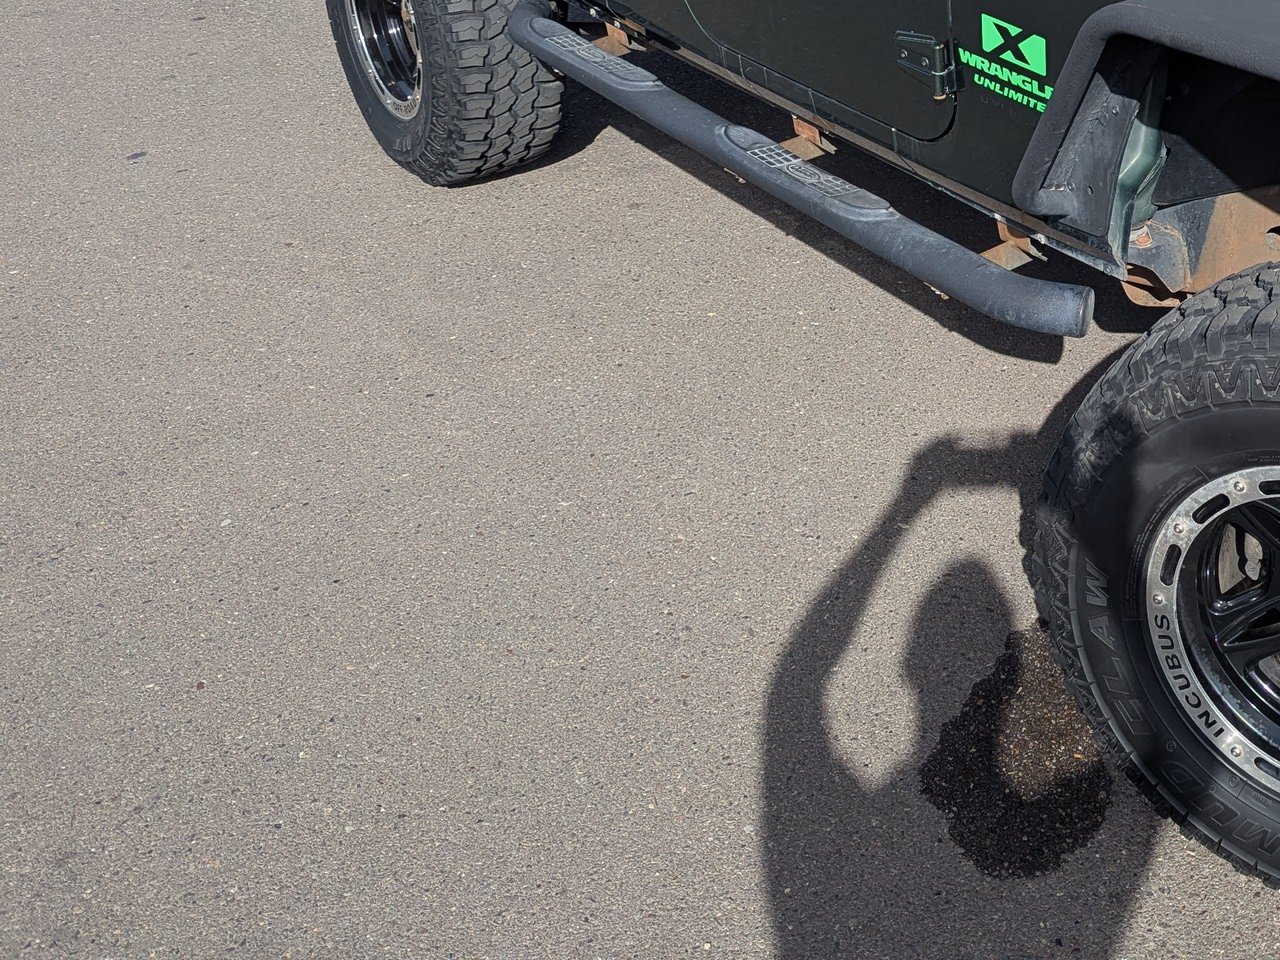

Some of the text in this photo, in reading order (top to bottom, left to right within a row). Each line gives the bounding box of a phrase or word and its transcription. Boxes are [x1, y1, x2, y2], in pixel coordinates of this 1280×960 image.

[958, 47, 1055, 100] WRANGLE
[973, 73, 1047, 113] UNLIMITE
[1153, 612, 1226, 741] INCUBUS
